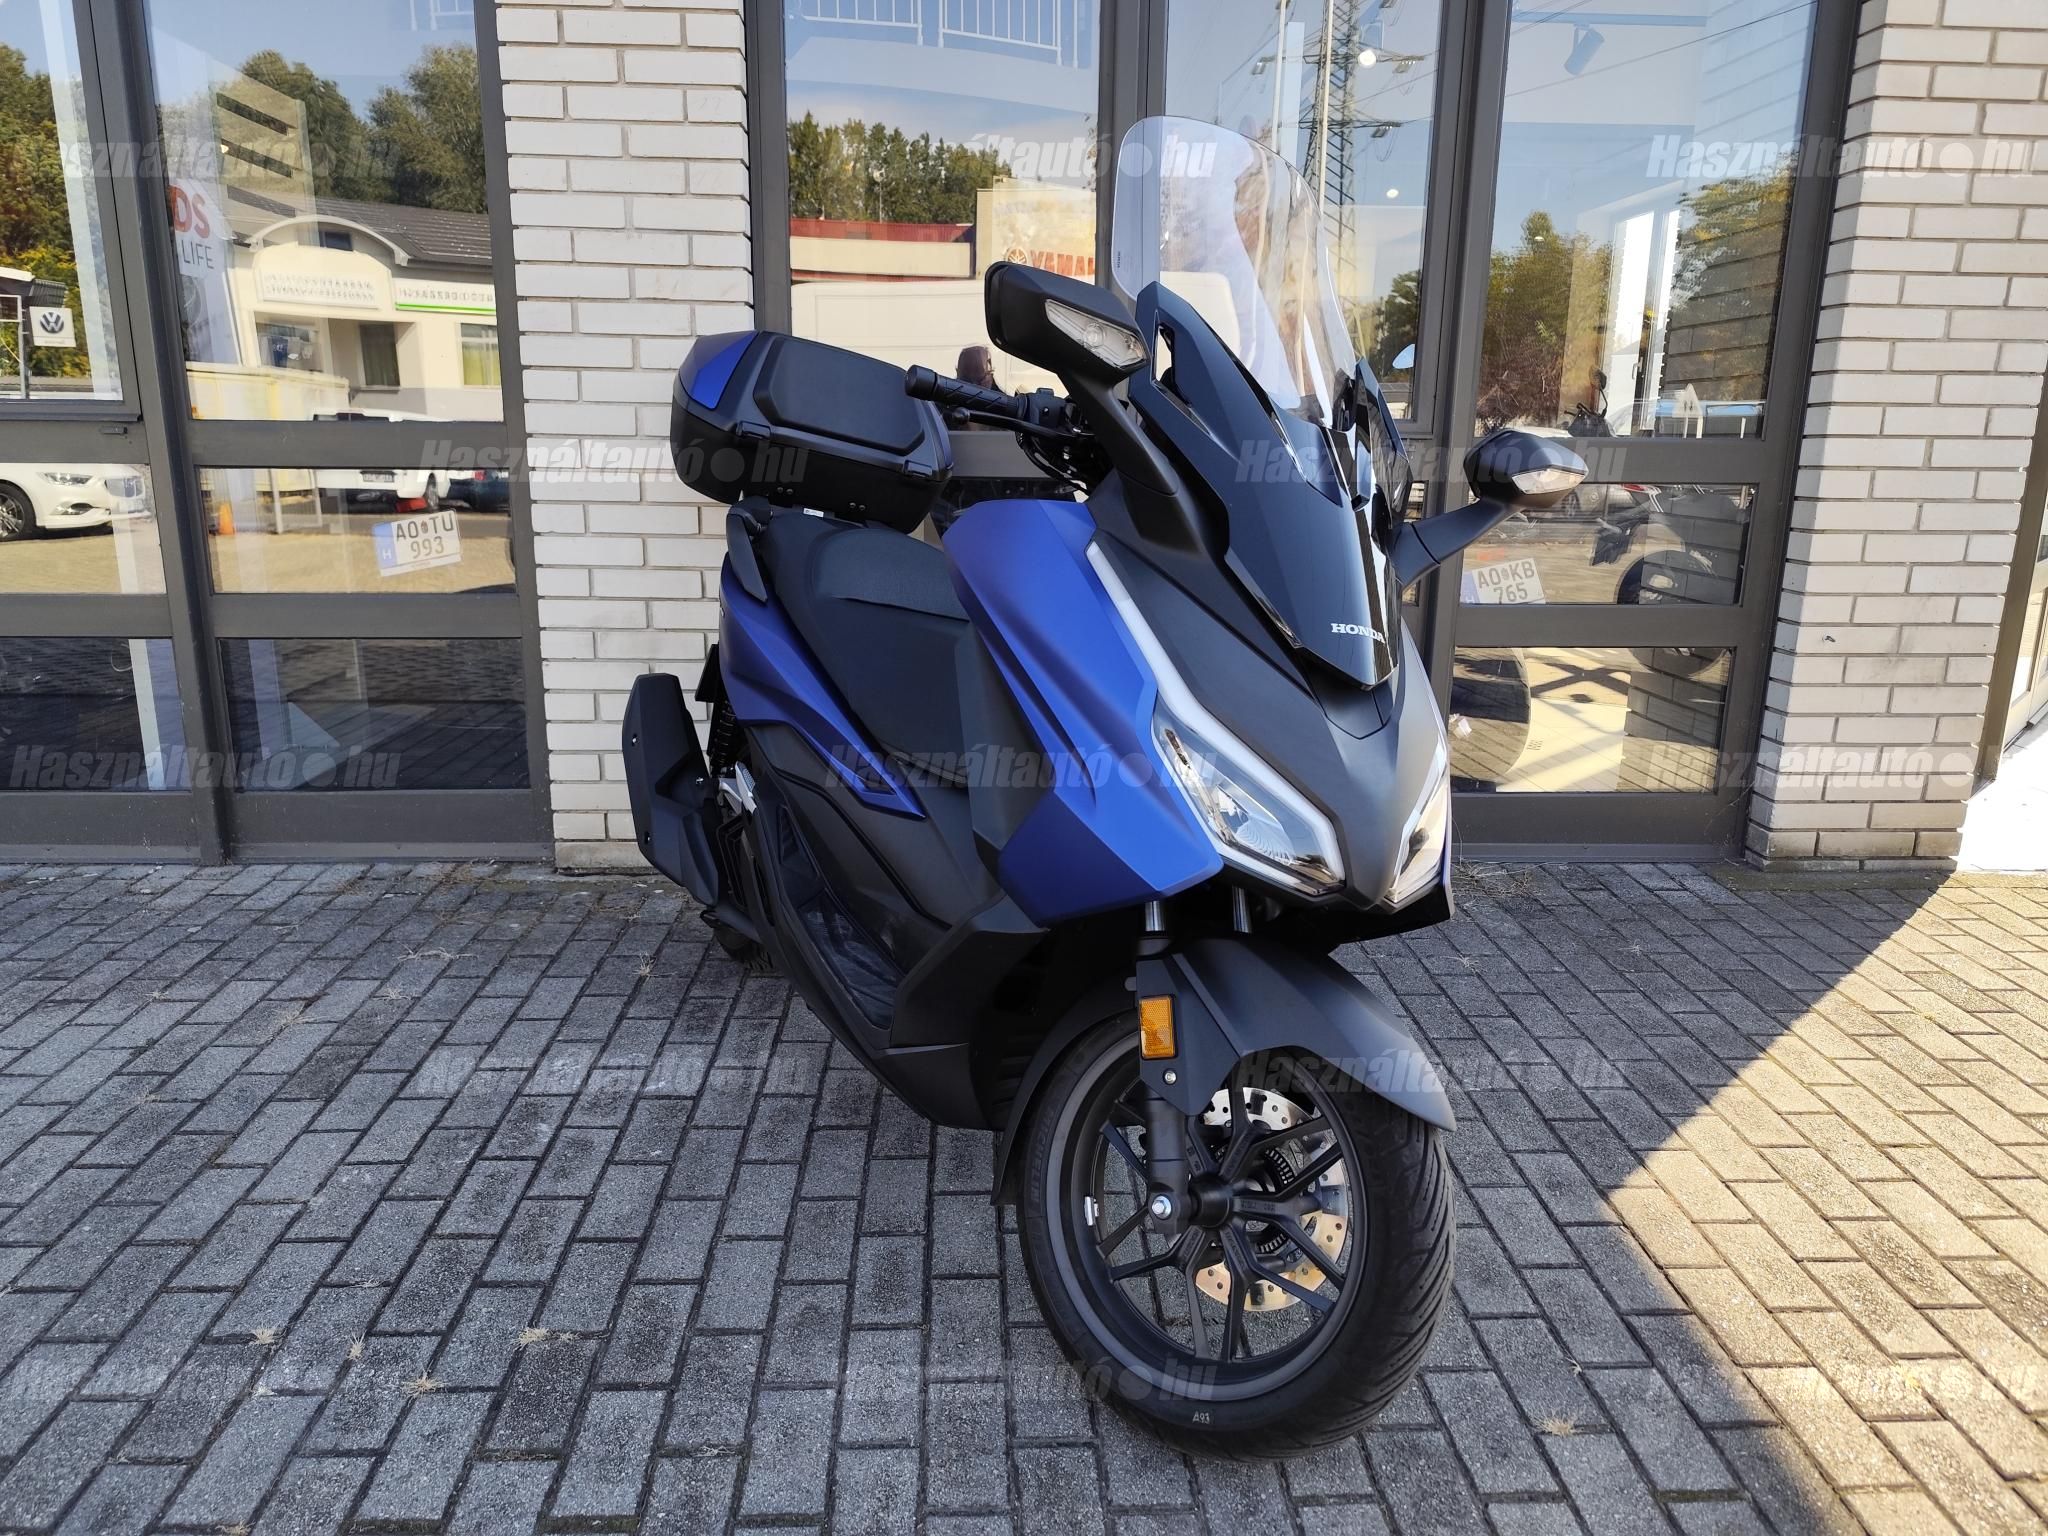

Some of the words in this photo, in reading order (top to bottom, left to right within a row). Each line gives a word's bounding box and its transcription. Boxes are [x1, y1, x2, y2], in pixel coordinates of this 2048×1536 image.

[182, 239, 215, 269] LIFE
[410, 536, 444, 559] 993
[1508, 561, 1535, 581] KB
[1493, 583, 1528, 604] 765
[1330, 622, 1386, 644] HONDA
[1192, 1410, 1210, 1425] A93
